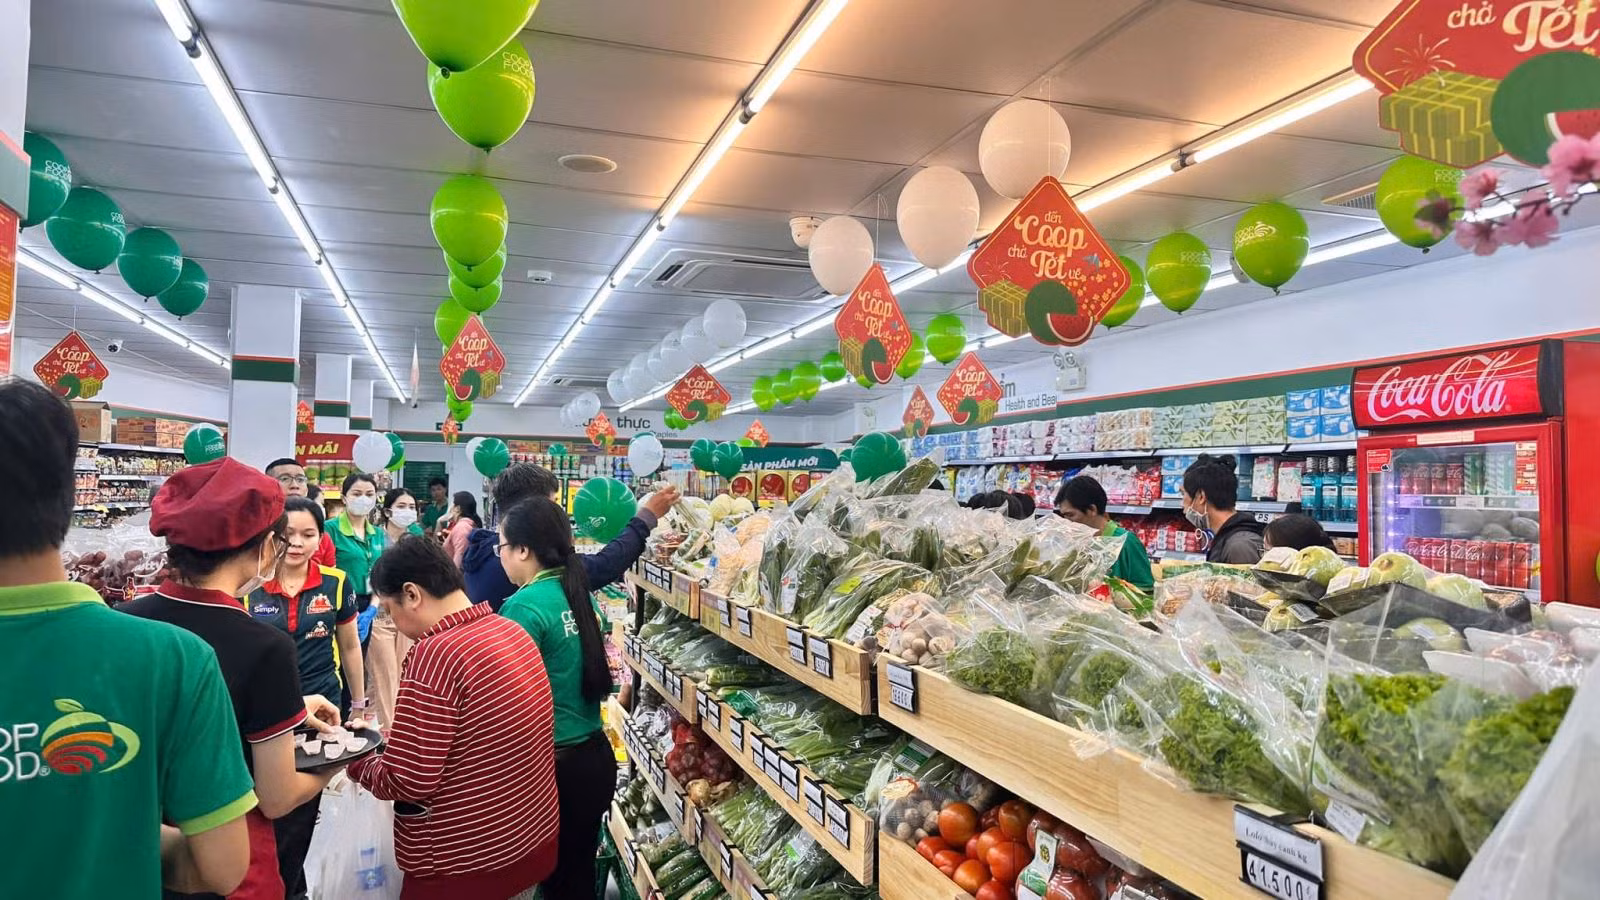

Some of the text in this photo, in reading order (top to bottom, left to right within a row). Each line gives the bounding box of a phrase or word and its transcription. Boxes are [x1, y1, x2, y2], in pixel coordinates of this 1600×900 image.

[1502, 0, 1600, 52] Tết
[1014, 215, 1088, 257] Coop
[1030, 250, 1070, 280] Tết
[858, 291, 893, 322] Coop
[458, 336, 488, 354] Coop
[57, 347, 90, 364] Coop
[685, 377, 715, 391] Coop
[955, 368, 986, 386] Coop
[1005, 399, 1025, 411] Health
[1027, 395, 1040, 408] and
[617, 416, 651, 432] thực
[309, 441, 339, 455] MÃI
[741, 456, 819, 472] SẢN PHẨM MỚI
[254, 604, 279, 615] Simply
[1249, 859, 1304, 900] 41.500
